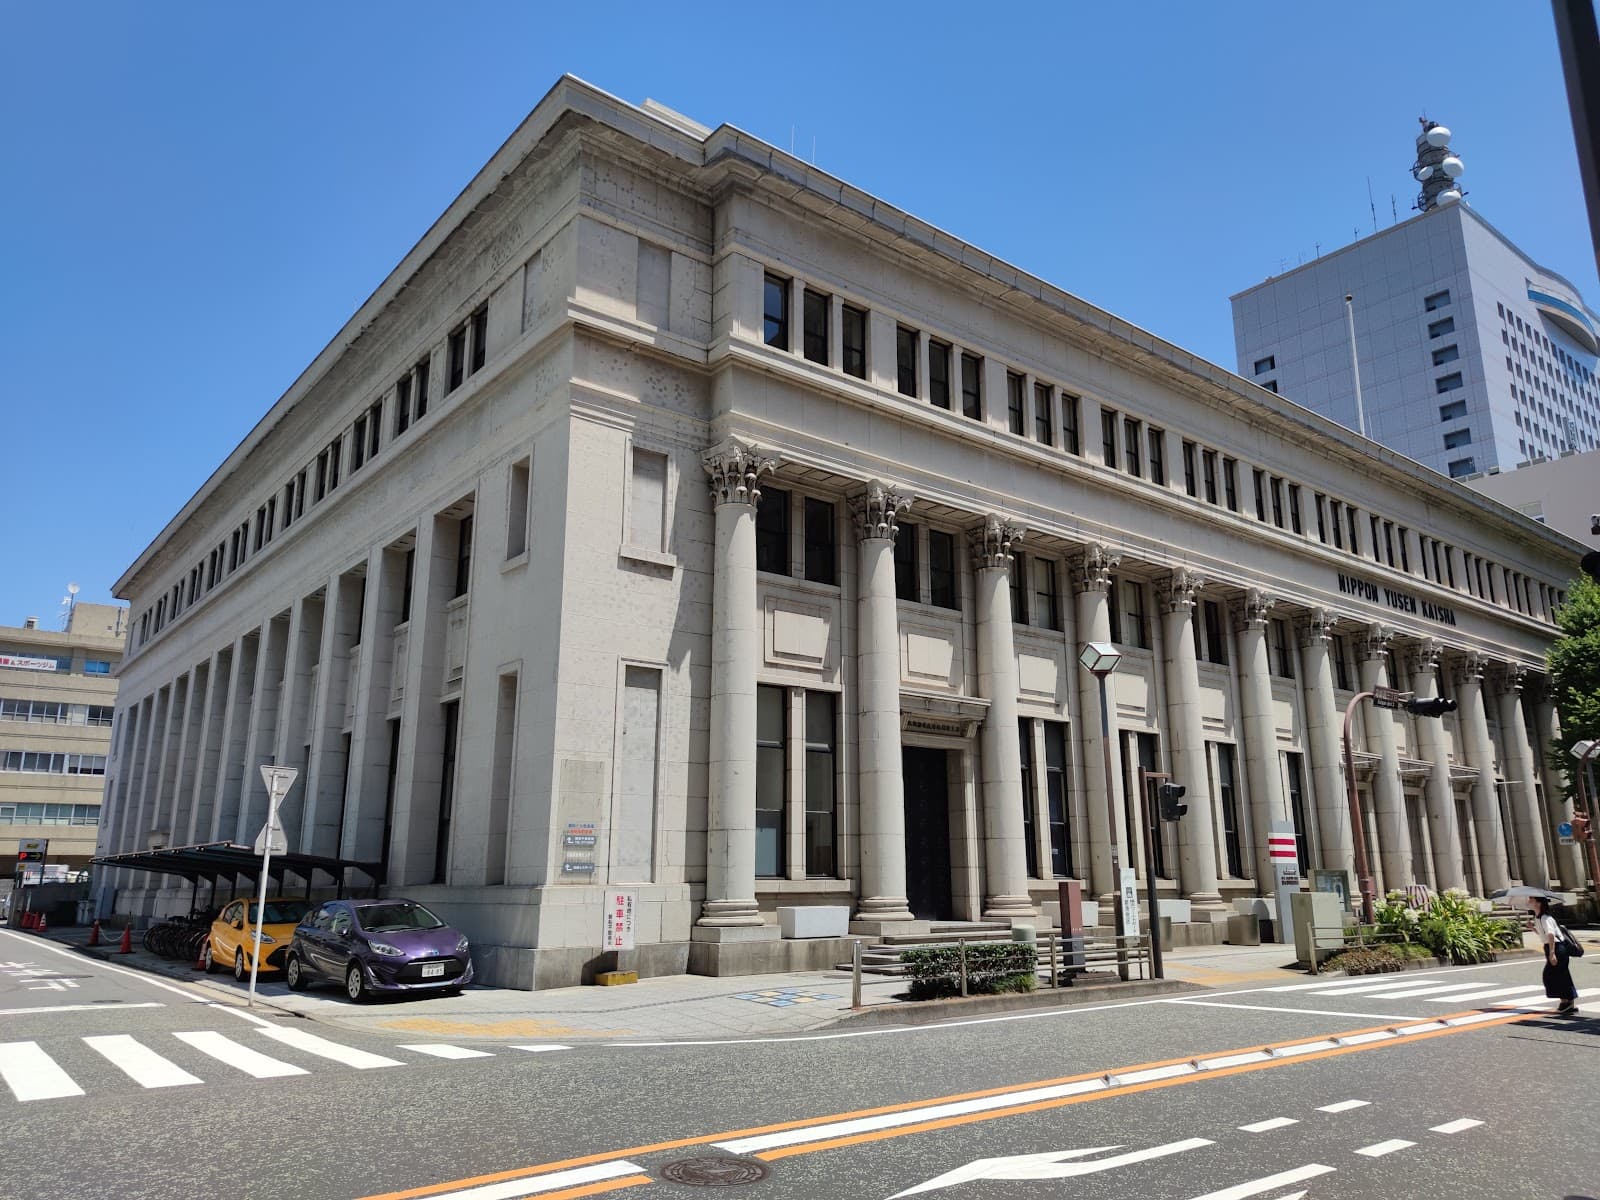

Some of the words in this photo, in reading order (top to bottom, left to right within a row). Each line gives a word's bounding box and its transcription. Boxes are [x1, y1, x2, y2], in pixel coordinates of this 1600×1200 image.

[1338, 574, 1379, 602] NIPPON
[1384, 588, 1417, 614] YUSEN
[1421, 600, 1456, 626] KAISHA
[20, 852, 27, 861] P
[615, 895, 624, 946] 駐車禁止
